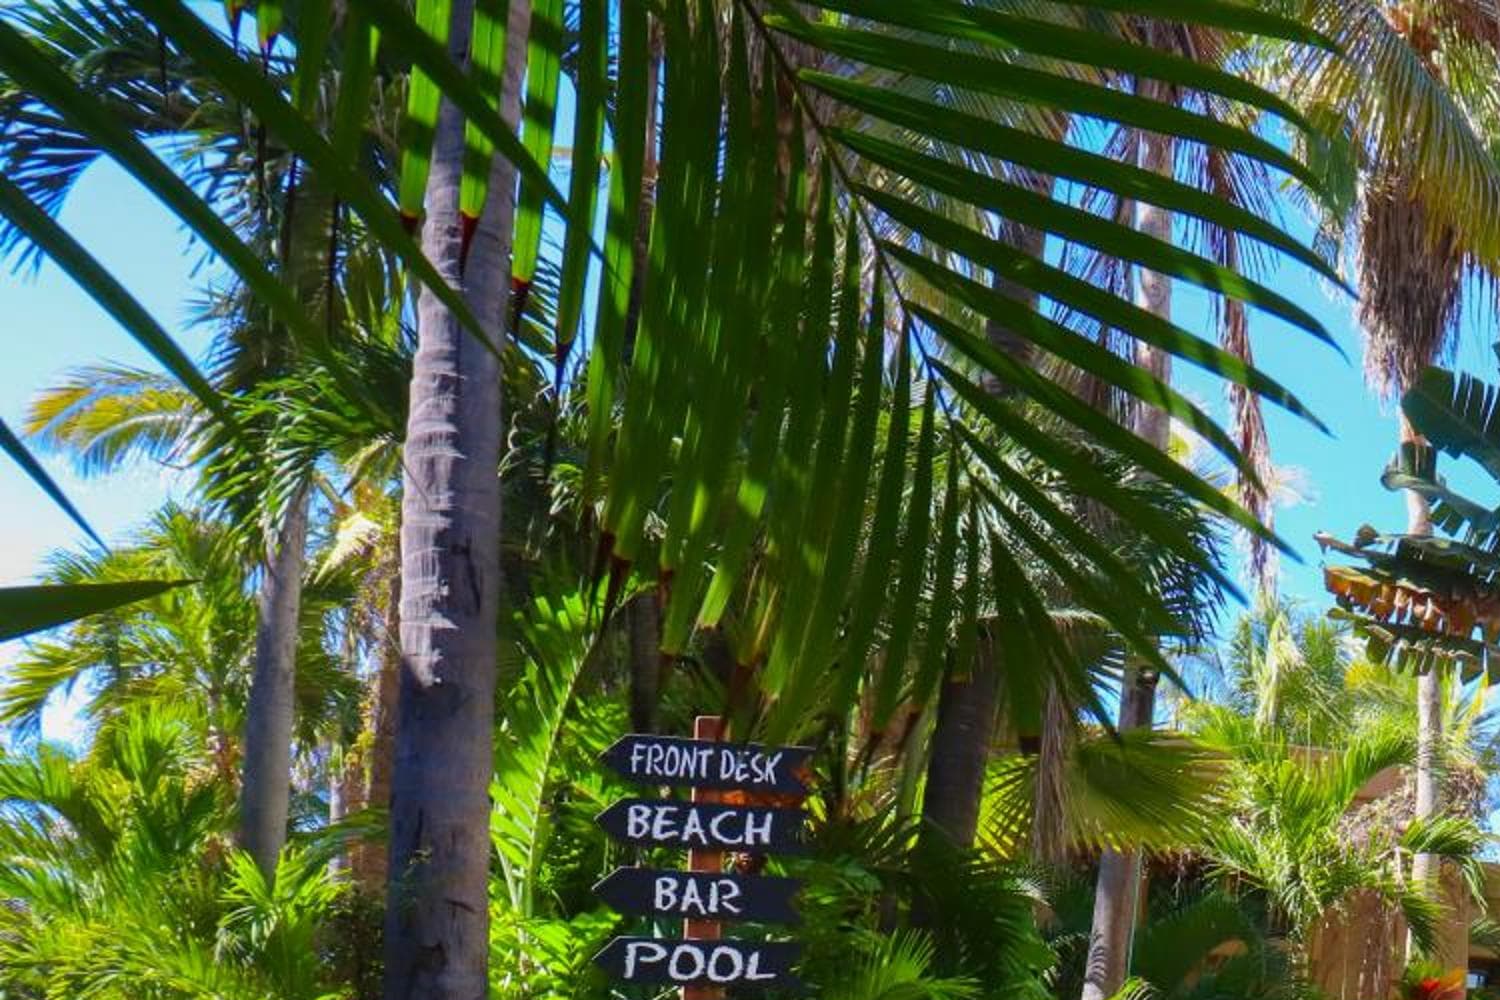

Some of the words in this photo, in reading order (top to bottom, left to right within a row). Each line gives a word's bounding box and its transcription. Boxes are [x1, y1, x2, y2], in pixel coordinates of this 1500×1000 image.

[629, 742, 714, 779] FRONT
[718, 749, 784, 786] DESK
[626, 804, 774, 846] BEACH
[654, 875, 742, 915] BAR
[623, 941, 777, 983] POOL
